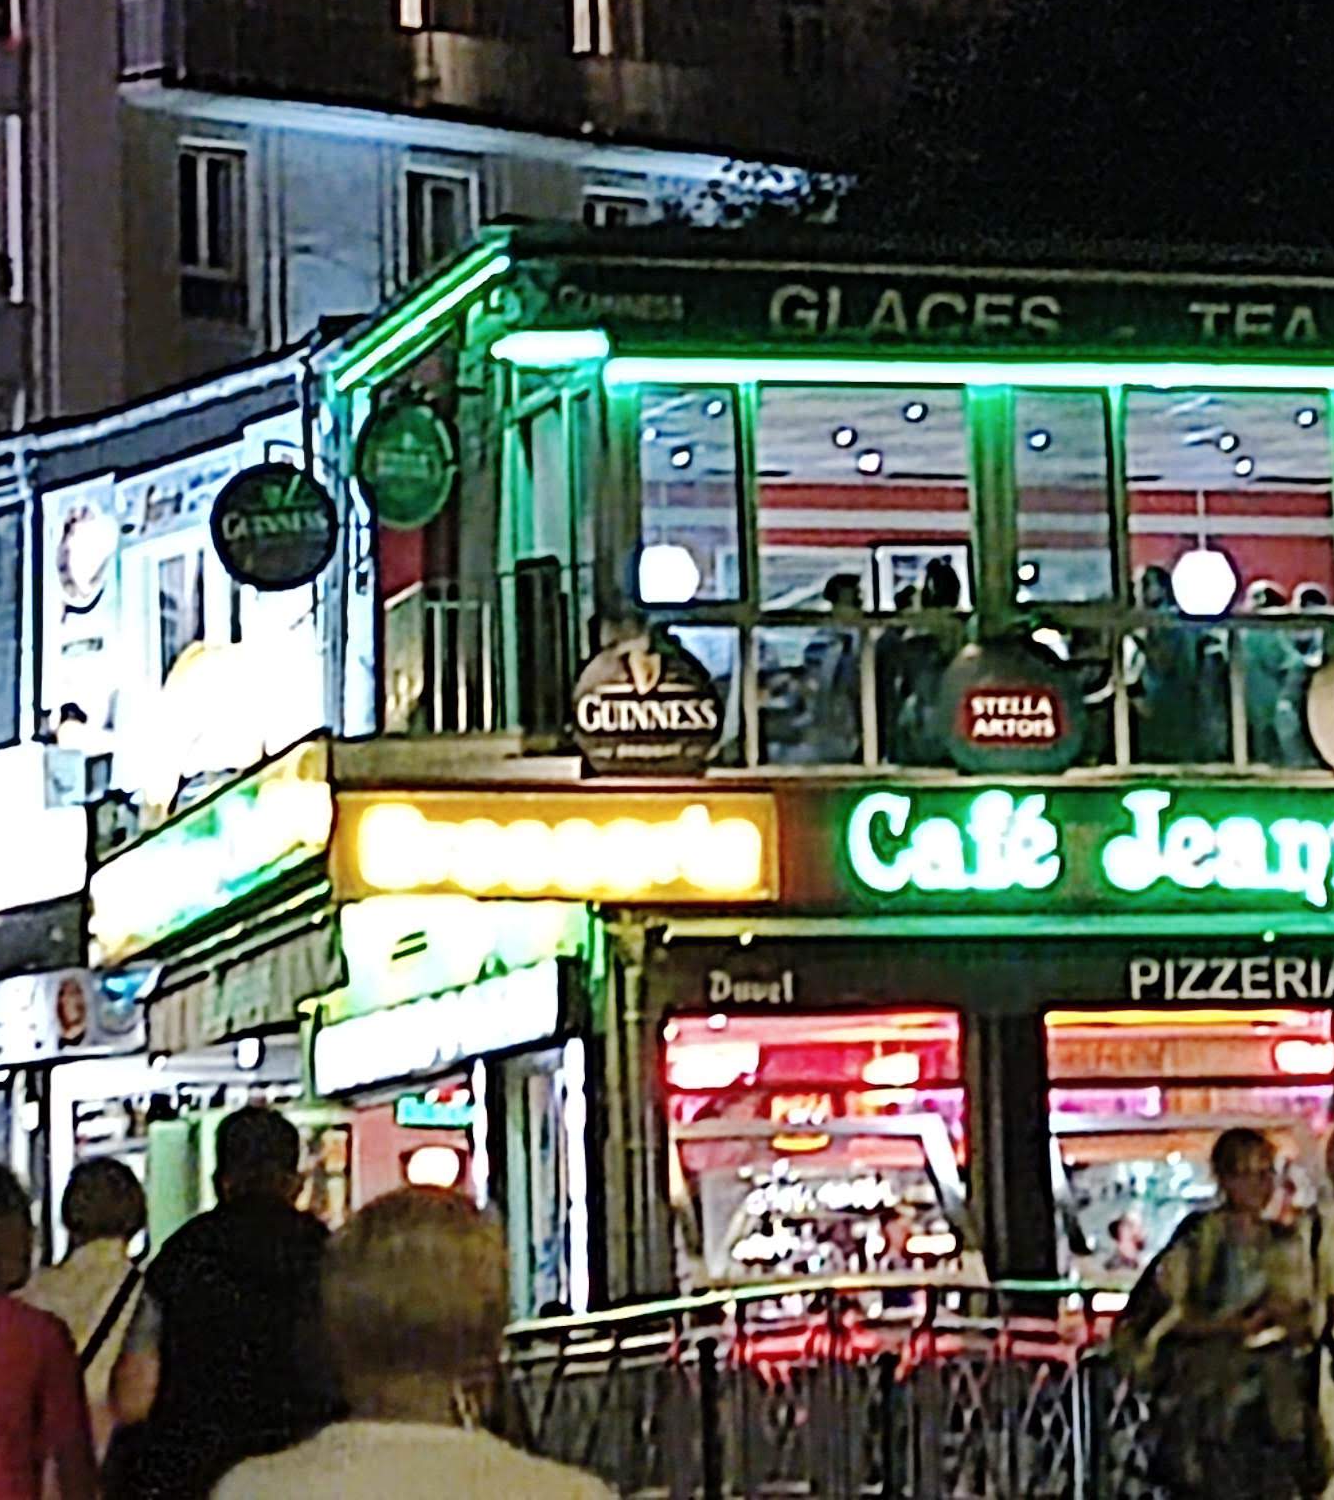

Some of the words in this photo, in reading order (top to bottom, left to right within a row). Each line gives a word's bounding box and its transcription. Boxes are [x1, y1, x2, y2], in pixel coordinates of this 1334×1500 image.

[767, 282, 1063, 335] GLACES
[1188, 301, 1317, 342] TEA
[577, 694, 718, 732] GUINNESS
[971, 696, 1053, 716] STELLA
[971, 717, 1056, 738] ARTOIS
[848, 789, 1061, 892] Café
